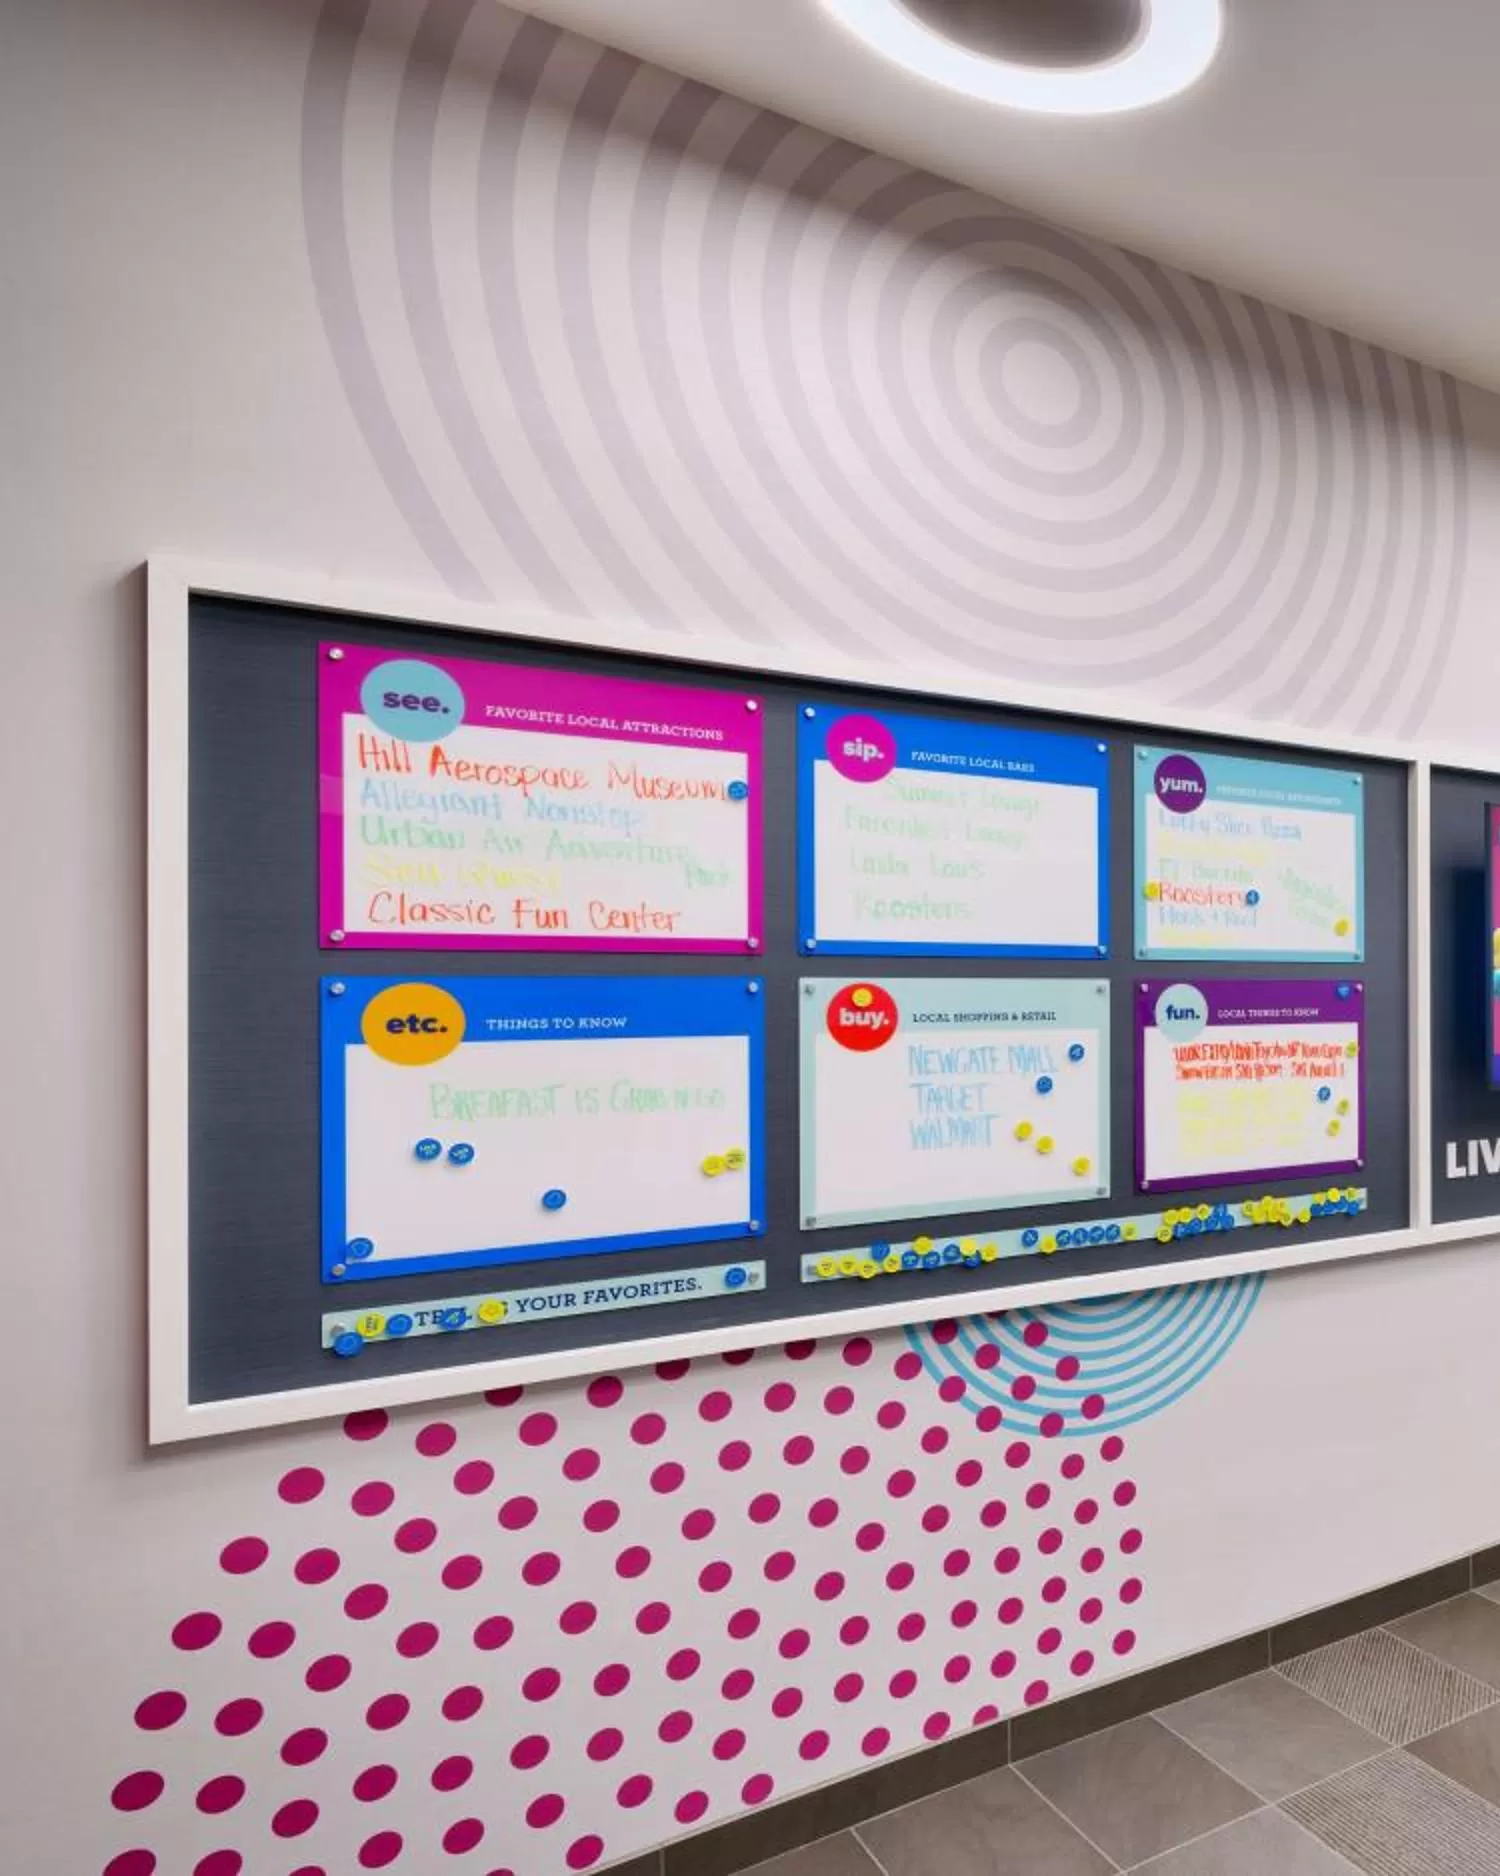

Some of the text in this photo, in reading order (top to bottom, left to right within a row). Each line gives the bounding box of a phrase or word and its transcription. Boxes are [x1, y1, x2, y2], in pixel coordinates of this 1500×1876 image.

[383, 690, 450, 716] see.
[485, 704, 724, 742] FAVORITE LOCAL ATTRACTIONS
[843, 737, 885, 762] sip.
[911, 751, 967, 767] FAVORITE
[969, 756, 1005, 770] LOCAL
[357, 732, 728, 802] Hill Aerospace Museum
[1159, 776, 1203, 794] yum.
[359, 815, 466, 851] Urban
[368, 890, 682, 933] Classic Fun Center
[385, 1013, 449, 1035] etc.
[486, 1015, 629, 1032] THINGS TO KNOW
[840, 1007, 890, 1030] buy.
[912, 1013, 951, 1024] LOCAL
[953, 1012, 1009, 1023] SHOPPING
[1021, 1011, 1057, 1022] RETAIL
[1166, 1003, 1201, 1021] fun.
[515, 1292, 577, 1315] YOUR
[583, 1277, 703, 1306] FAVORITES.
